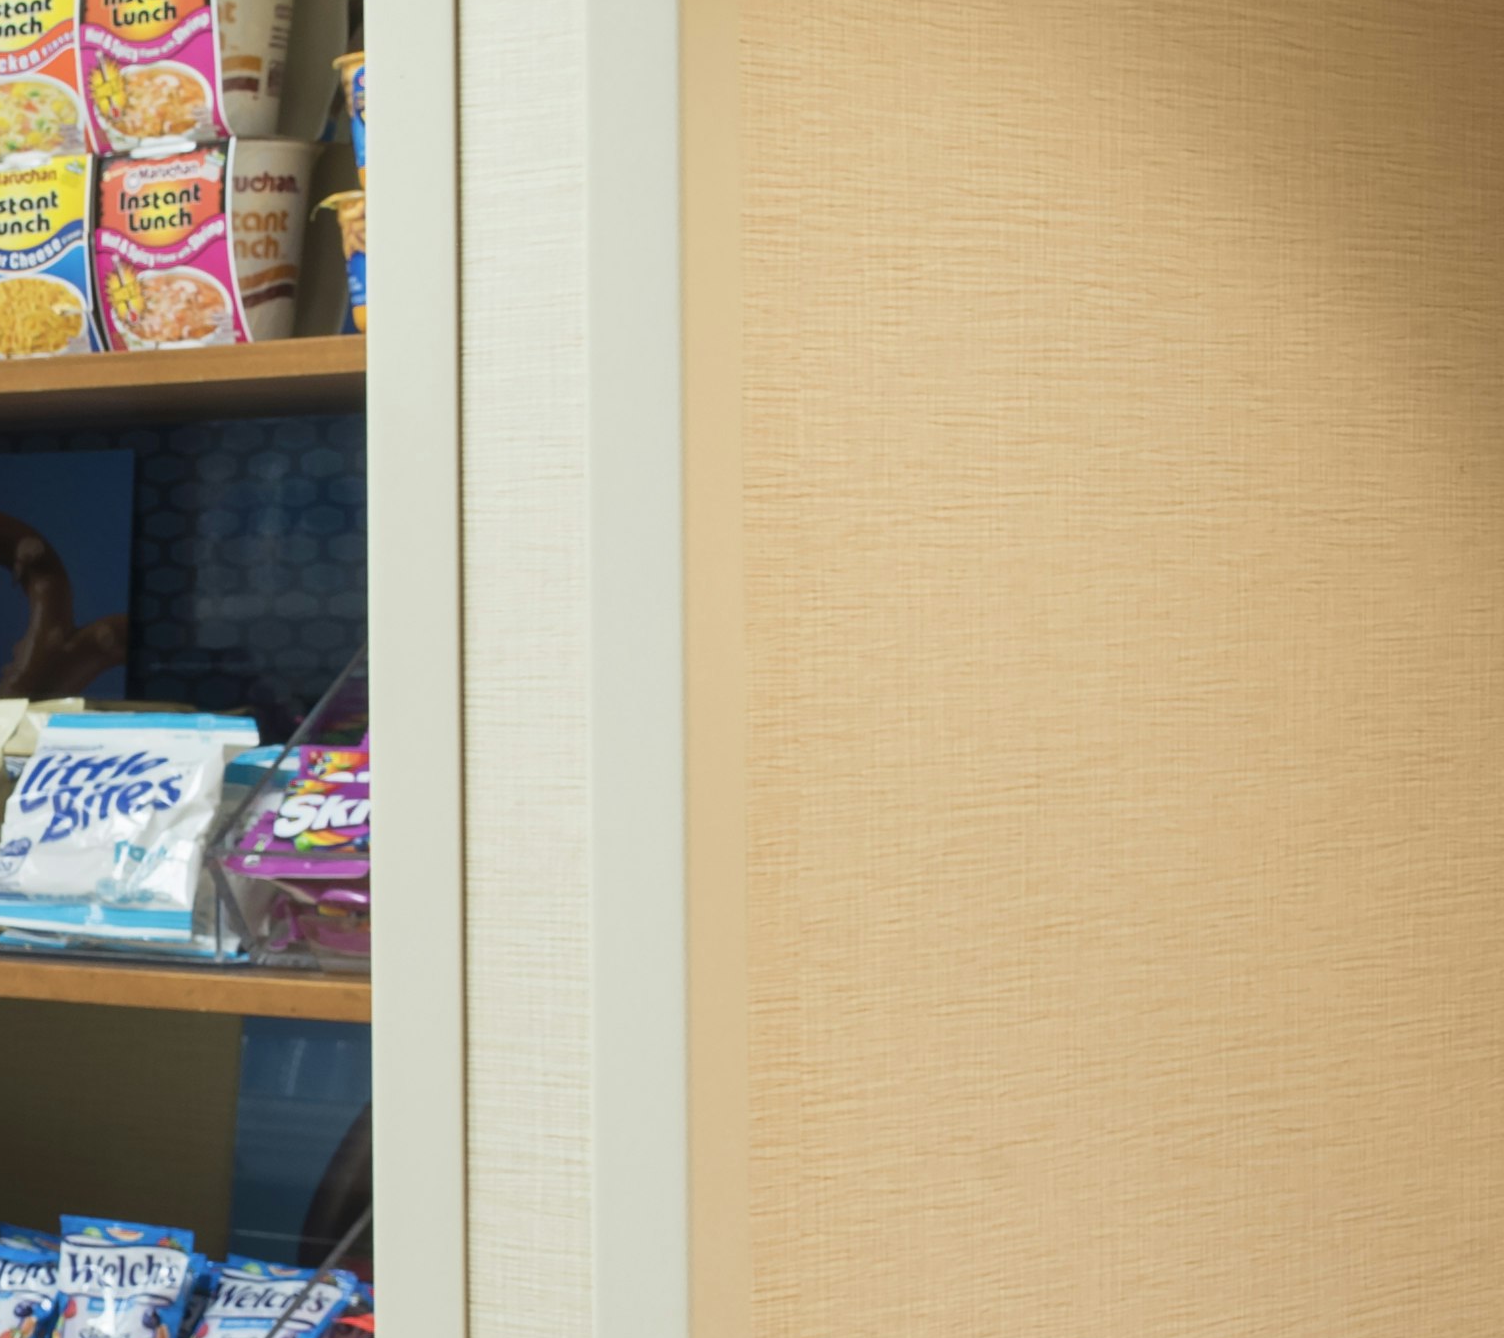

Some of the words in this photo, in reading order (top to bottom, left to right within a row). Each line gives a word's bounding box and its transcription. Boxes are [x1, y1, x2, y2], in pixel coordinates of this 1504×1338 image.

[112, 3, 177, 27] Lunch
[119, 184, 202, 212] Instant
[128, 211, 193, 234] Lunch
